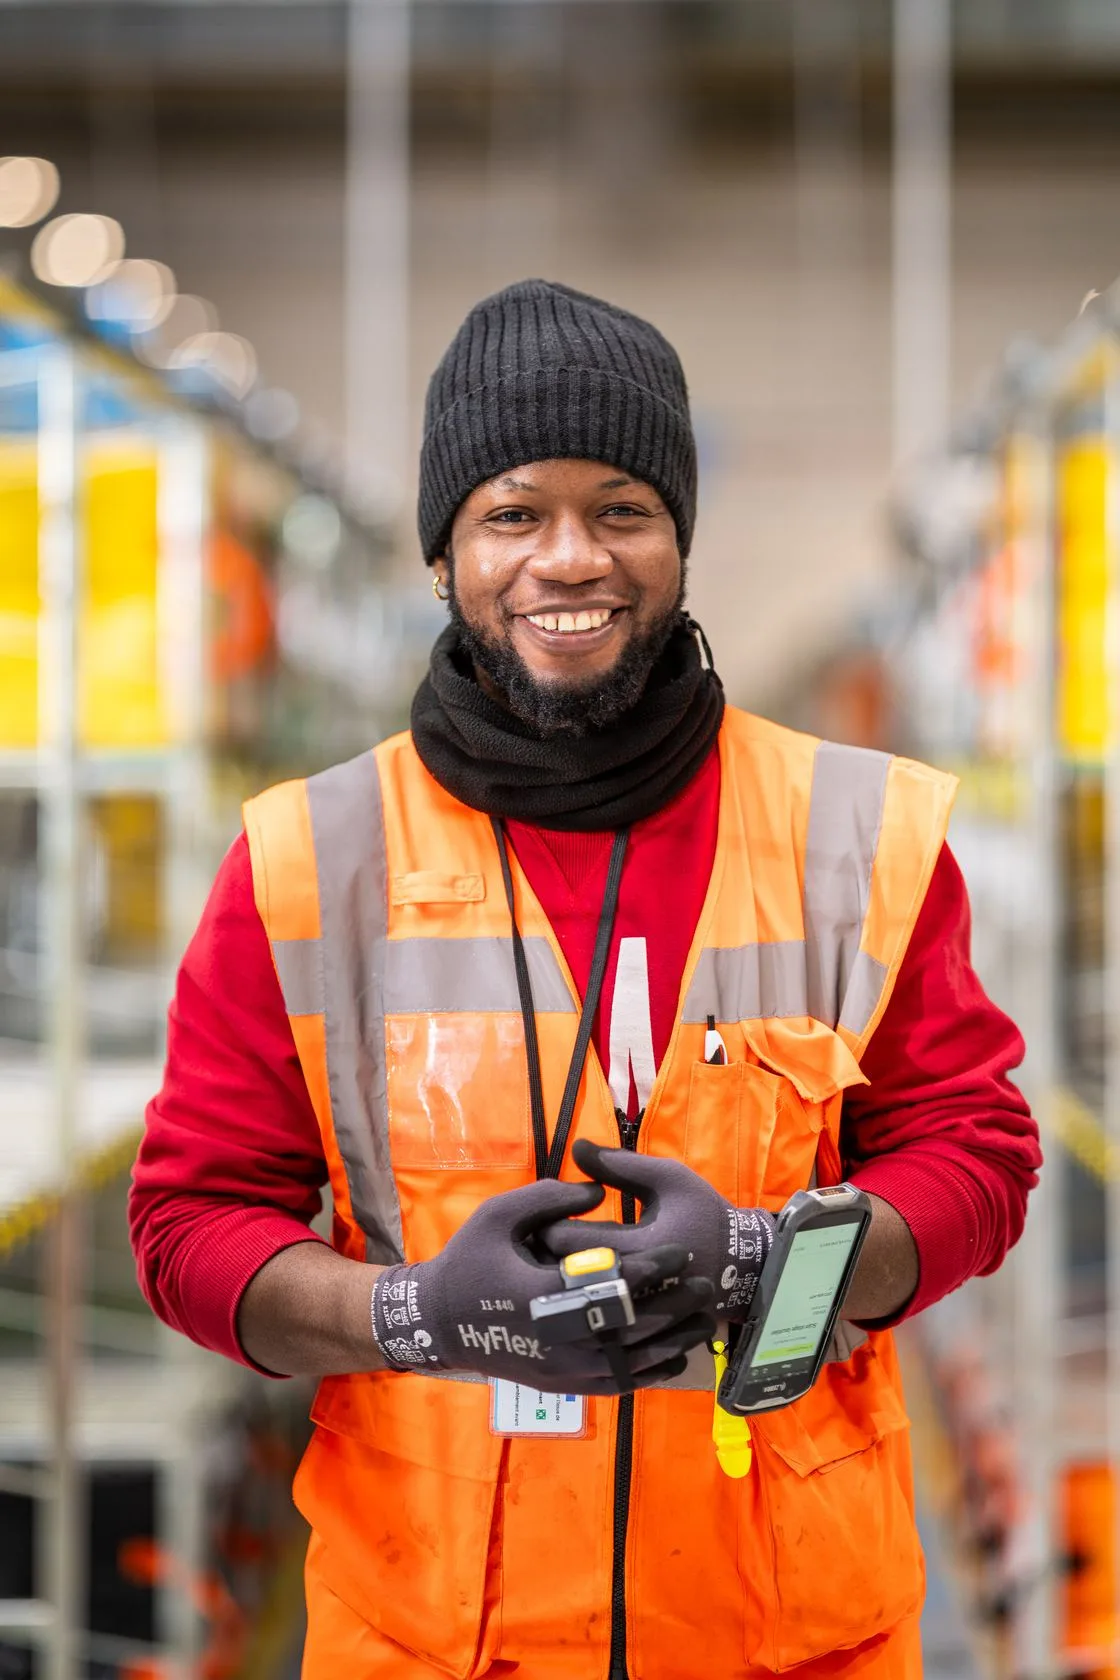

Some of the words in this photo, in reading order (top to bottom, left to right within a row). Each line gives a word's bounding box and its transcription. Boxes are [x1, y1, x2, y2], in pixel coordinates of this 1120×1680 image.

[727, 1208, 736, 1256] Ansell
[409, 1280, 422, 1322] Ansell
[479, 1299, 516, 1312] 11-840
[457, 1324, 546, 1360] HyFlex
